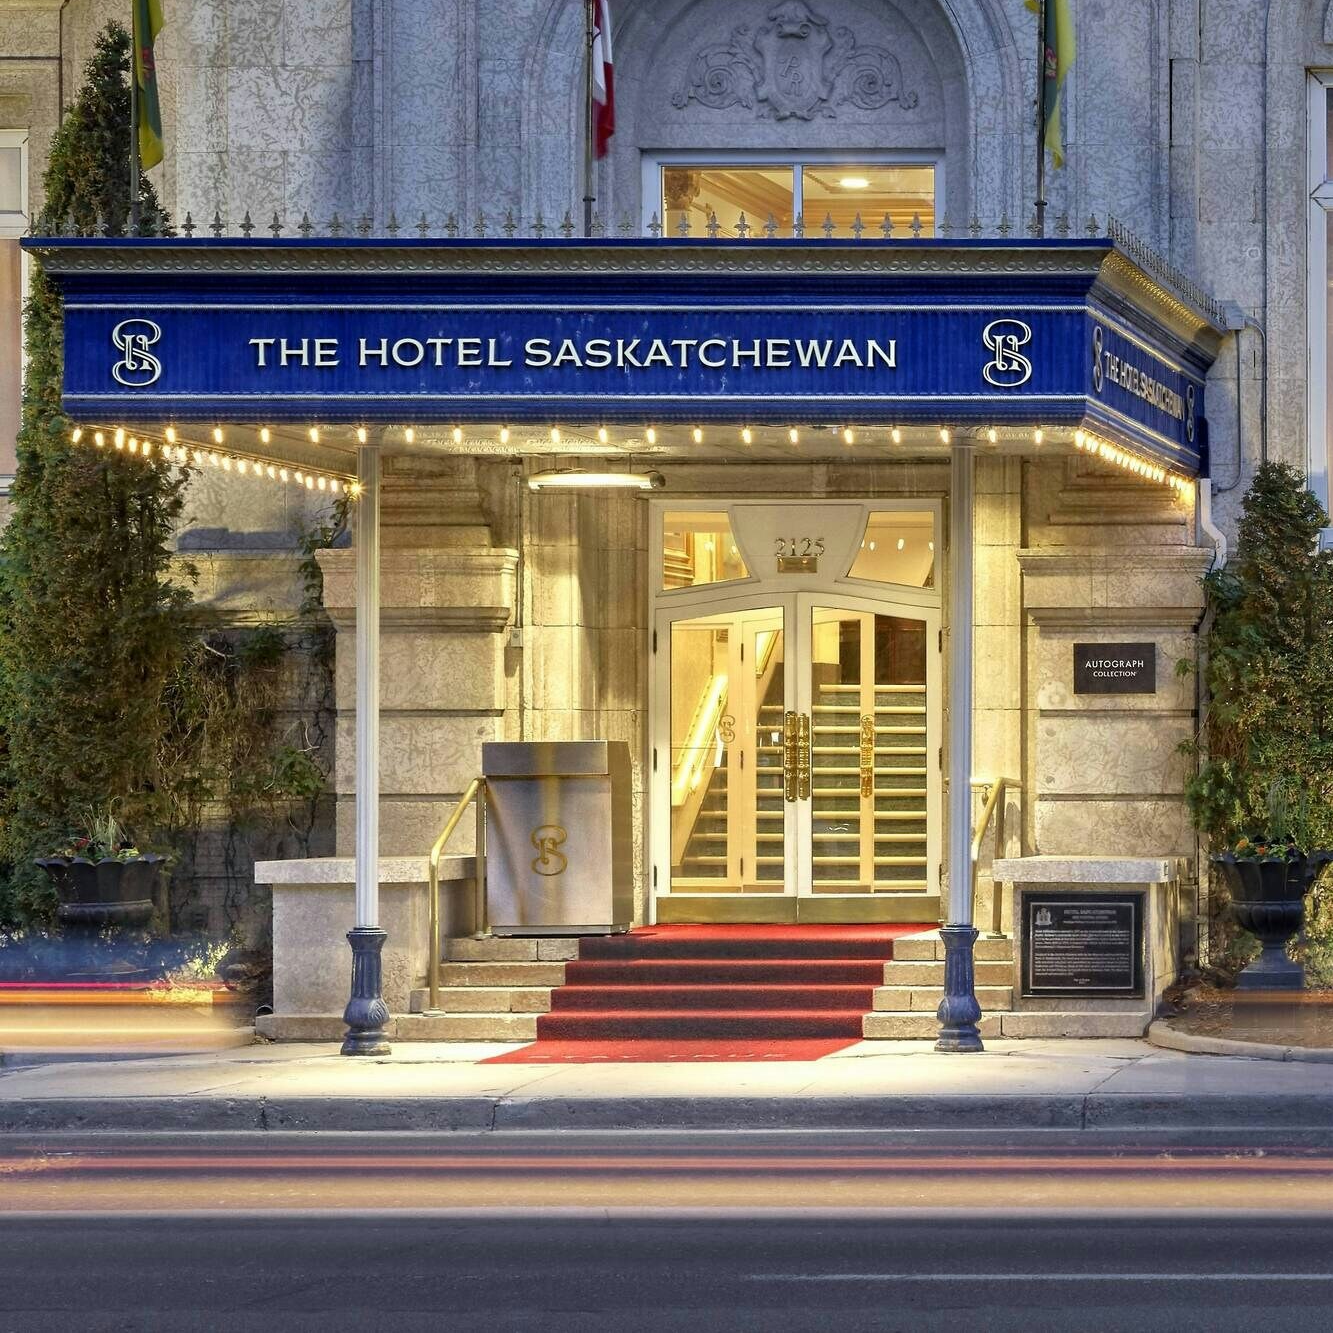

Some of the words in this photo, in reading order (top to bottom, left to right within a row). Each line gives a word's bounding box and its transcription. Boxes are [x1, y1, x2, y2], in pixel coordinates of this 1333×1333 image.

[248, 338, 340, 366] THE
[359, 338, 513, 366] HOTEL
[525, 338, 897, 367] SASKATCHEWAN
[1104, 351, 1119, 383] THE
[775, 537, 825, 556] 2125
[1085, 660, 1144, 668] AUTOGRAPH
